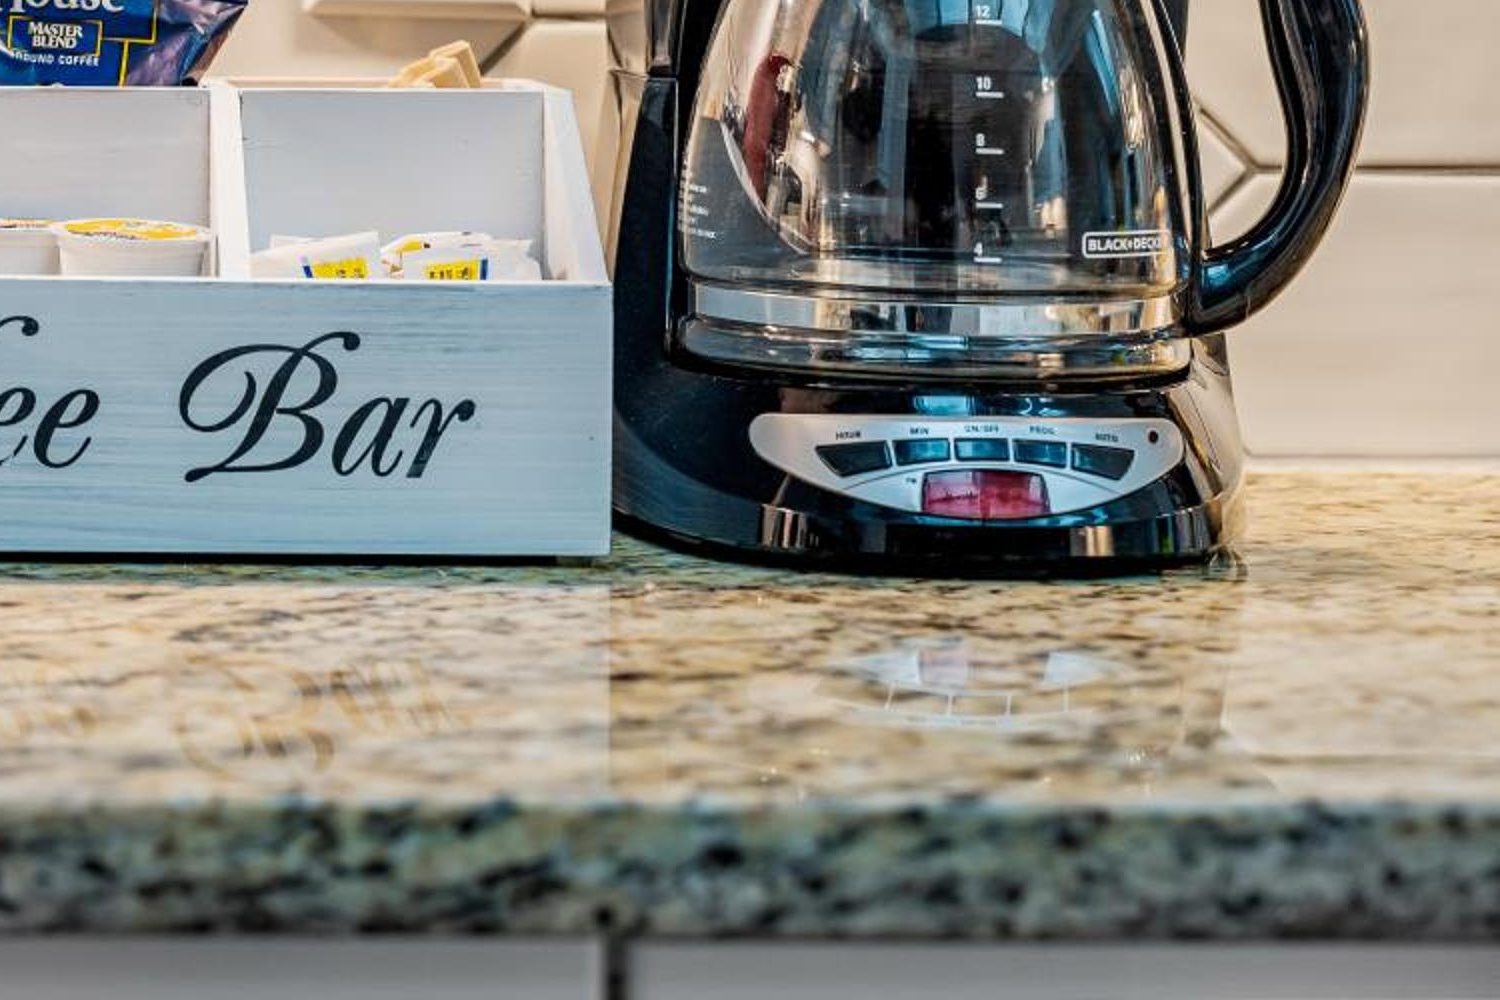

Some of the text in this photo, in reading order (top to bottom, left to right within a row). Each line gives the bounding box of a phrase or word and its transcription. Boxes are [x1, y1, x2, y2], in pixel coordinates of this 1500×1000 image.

[976, 5, 991, 18] 12
[28, 21, 84, 38] MASTER
[32, 35, 78, 49] BLEND
[10, 49, 100, 67] ROUND COFFEE
[976, 75, 992, 91] 10
[973, 241, 983, 256] 4
[178, 330, 476, 483] Bar
